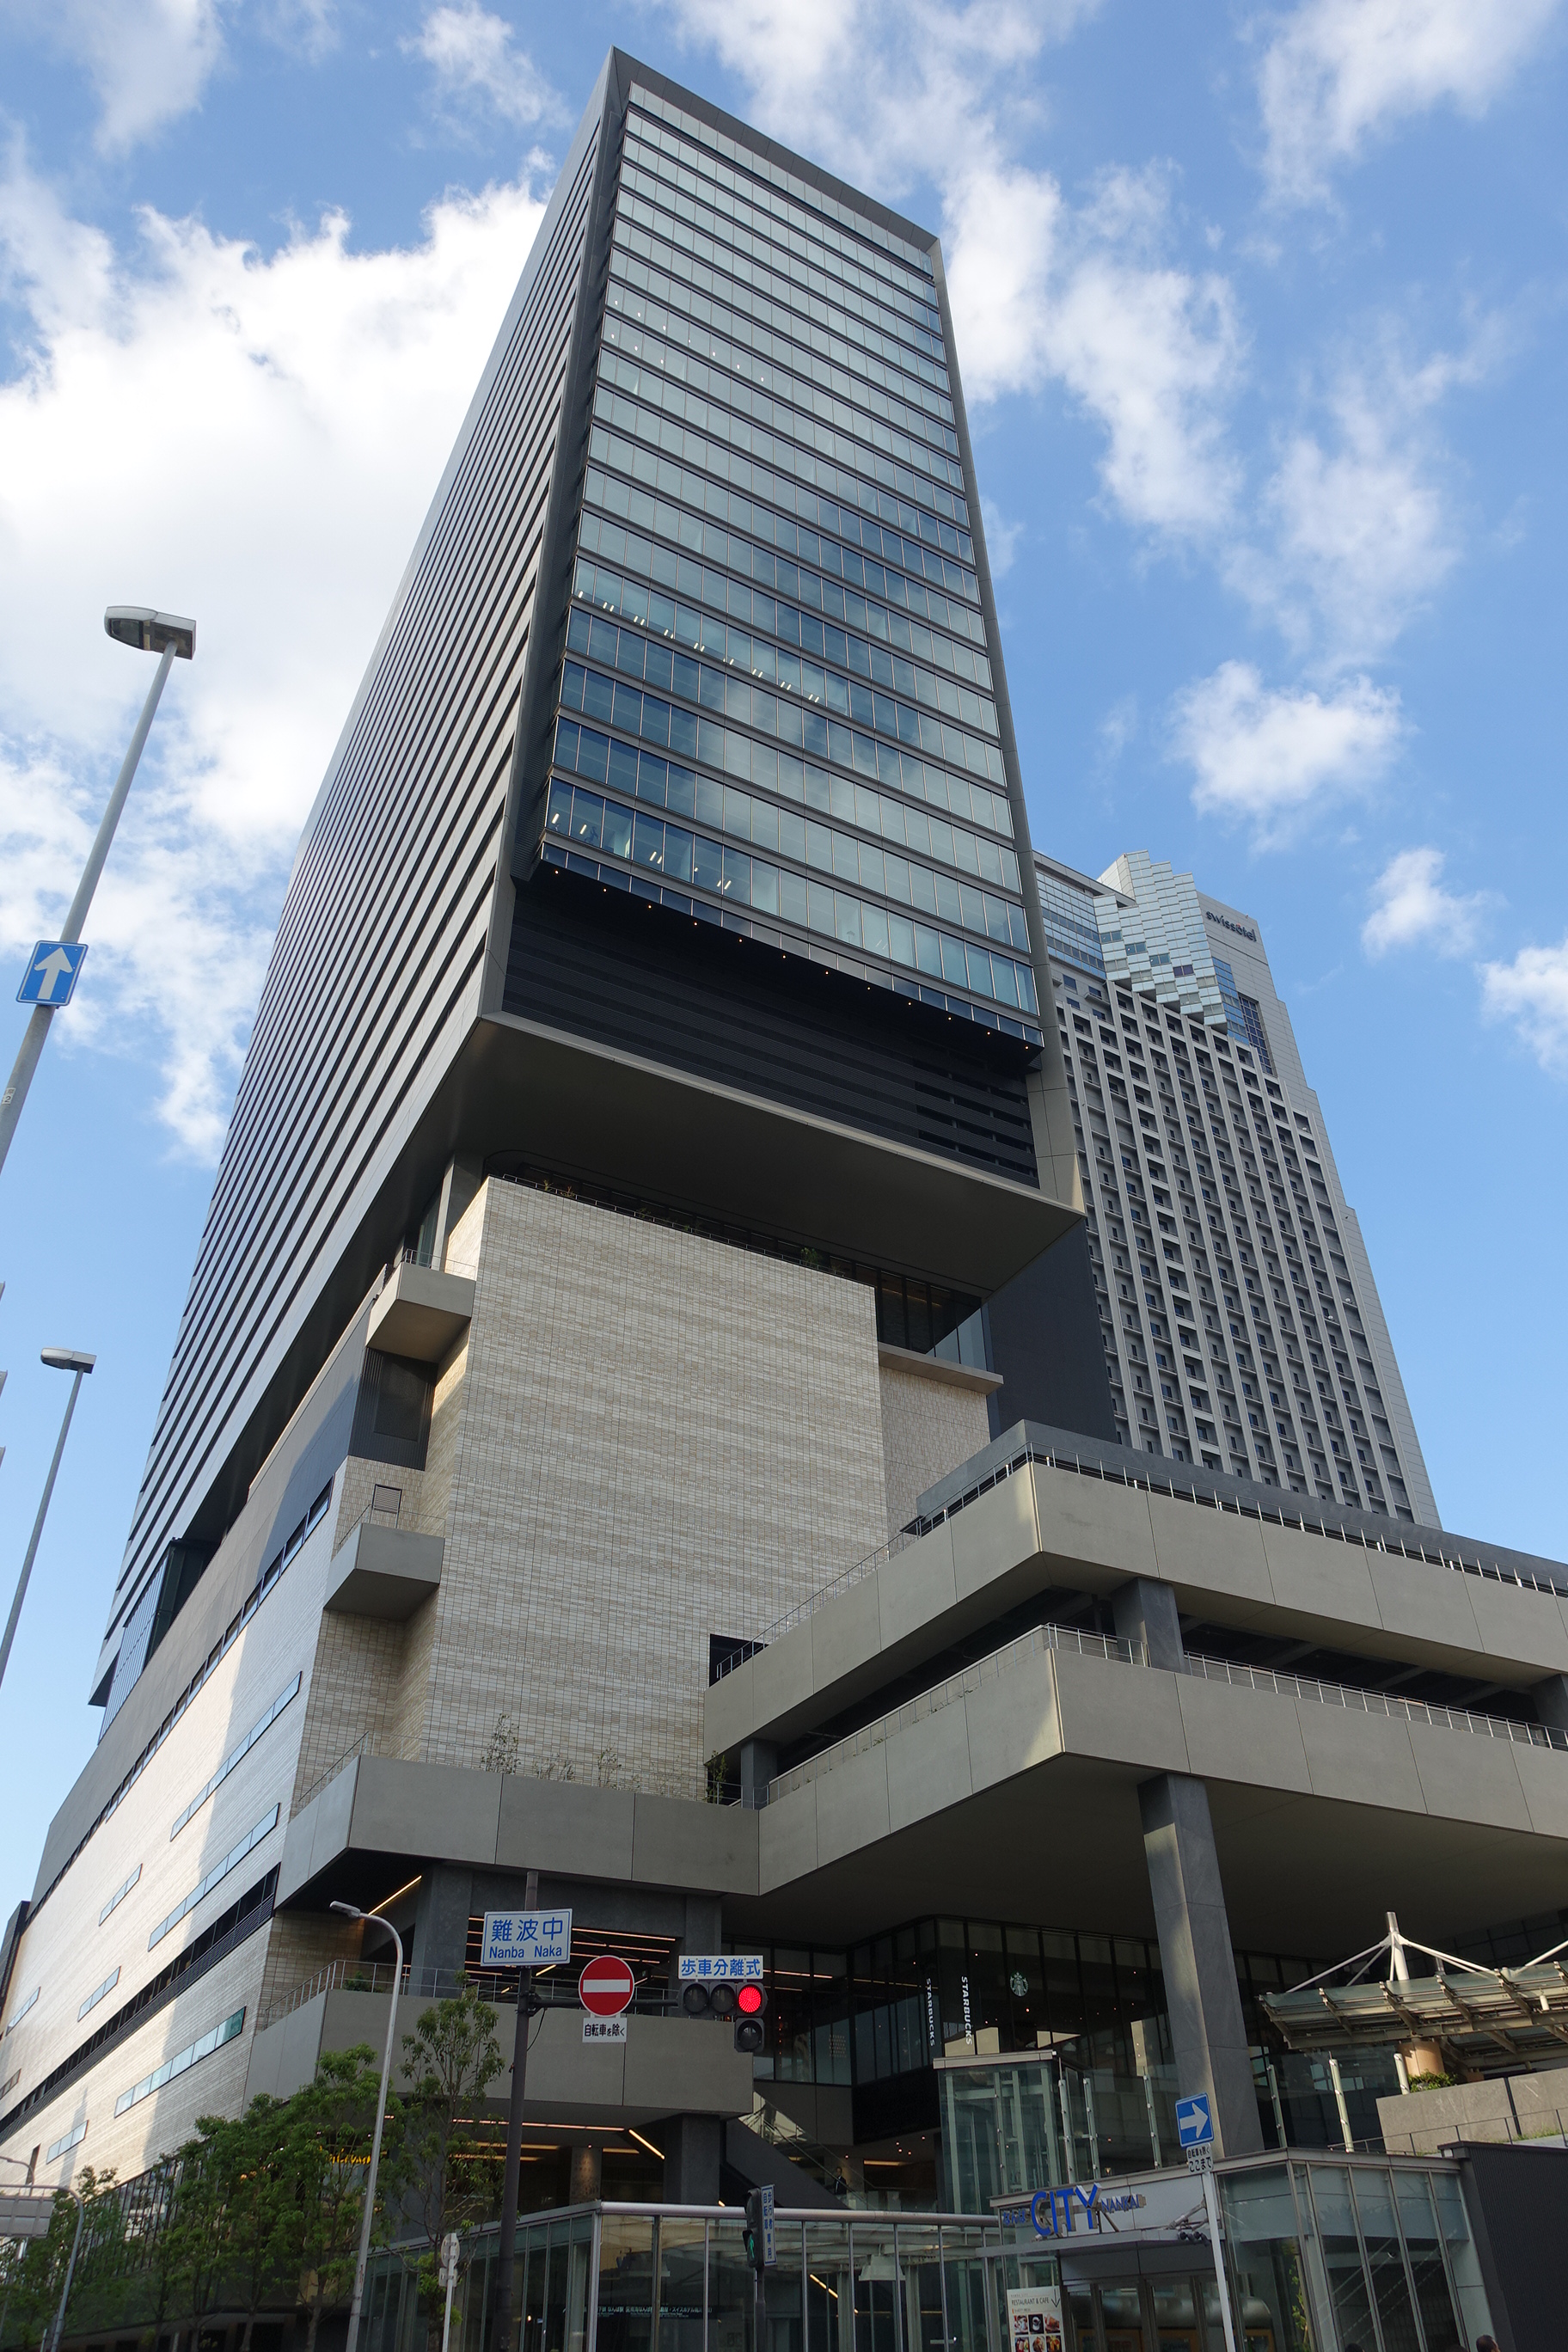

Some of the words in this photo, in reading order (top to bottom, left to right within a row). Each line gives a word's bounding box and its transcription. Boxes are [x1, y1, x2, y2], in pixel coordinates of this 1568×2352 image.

[491, 1916, 563, 1942] 難波中
[489, 1945, 524, 1959] Nanba
[534, 1945, 562, 1958] Naka
[681, 1958, 761, 1976] 歩車分離式
[926, 1977, 935, 2047] STARBUCKS
[961, 1975, 973, 2046] STARBUCKS
[585, 2023, 625, 2037] 自転車を除く
[1189, 2156, 1212, 2172] ここまで
[1031, 2183, 1100, 2237] CITY
[1101, 2194, 1142, 2214] NANKAI
